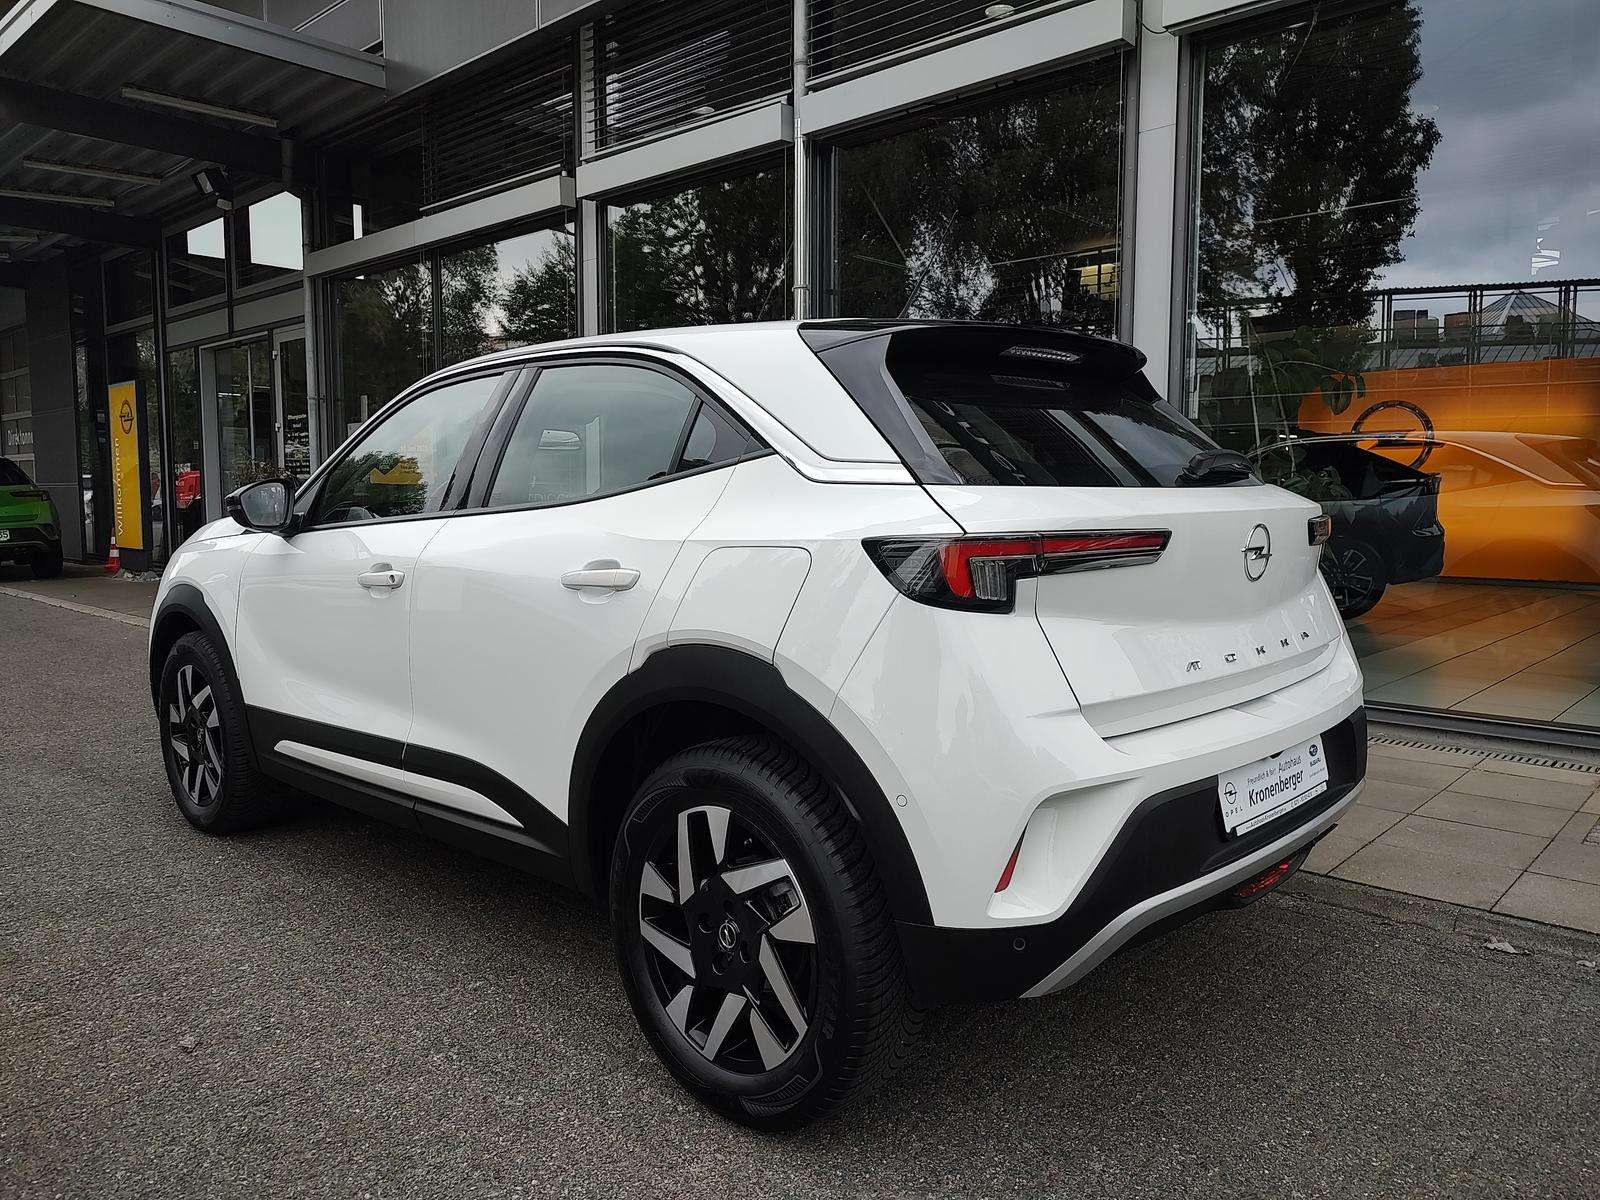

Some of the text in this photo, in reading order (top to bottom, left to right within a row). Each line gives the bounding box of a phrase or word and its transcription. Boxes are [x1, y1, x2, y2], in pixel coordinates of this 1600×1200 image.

[114, 437, 124, 536] Willkommen
[1278, 755, 1302, 774] Autohaus
[1248, 770, 1304, 808] Kronenberger
[1225, 805, 1243, 818] OPEL
